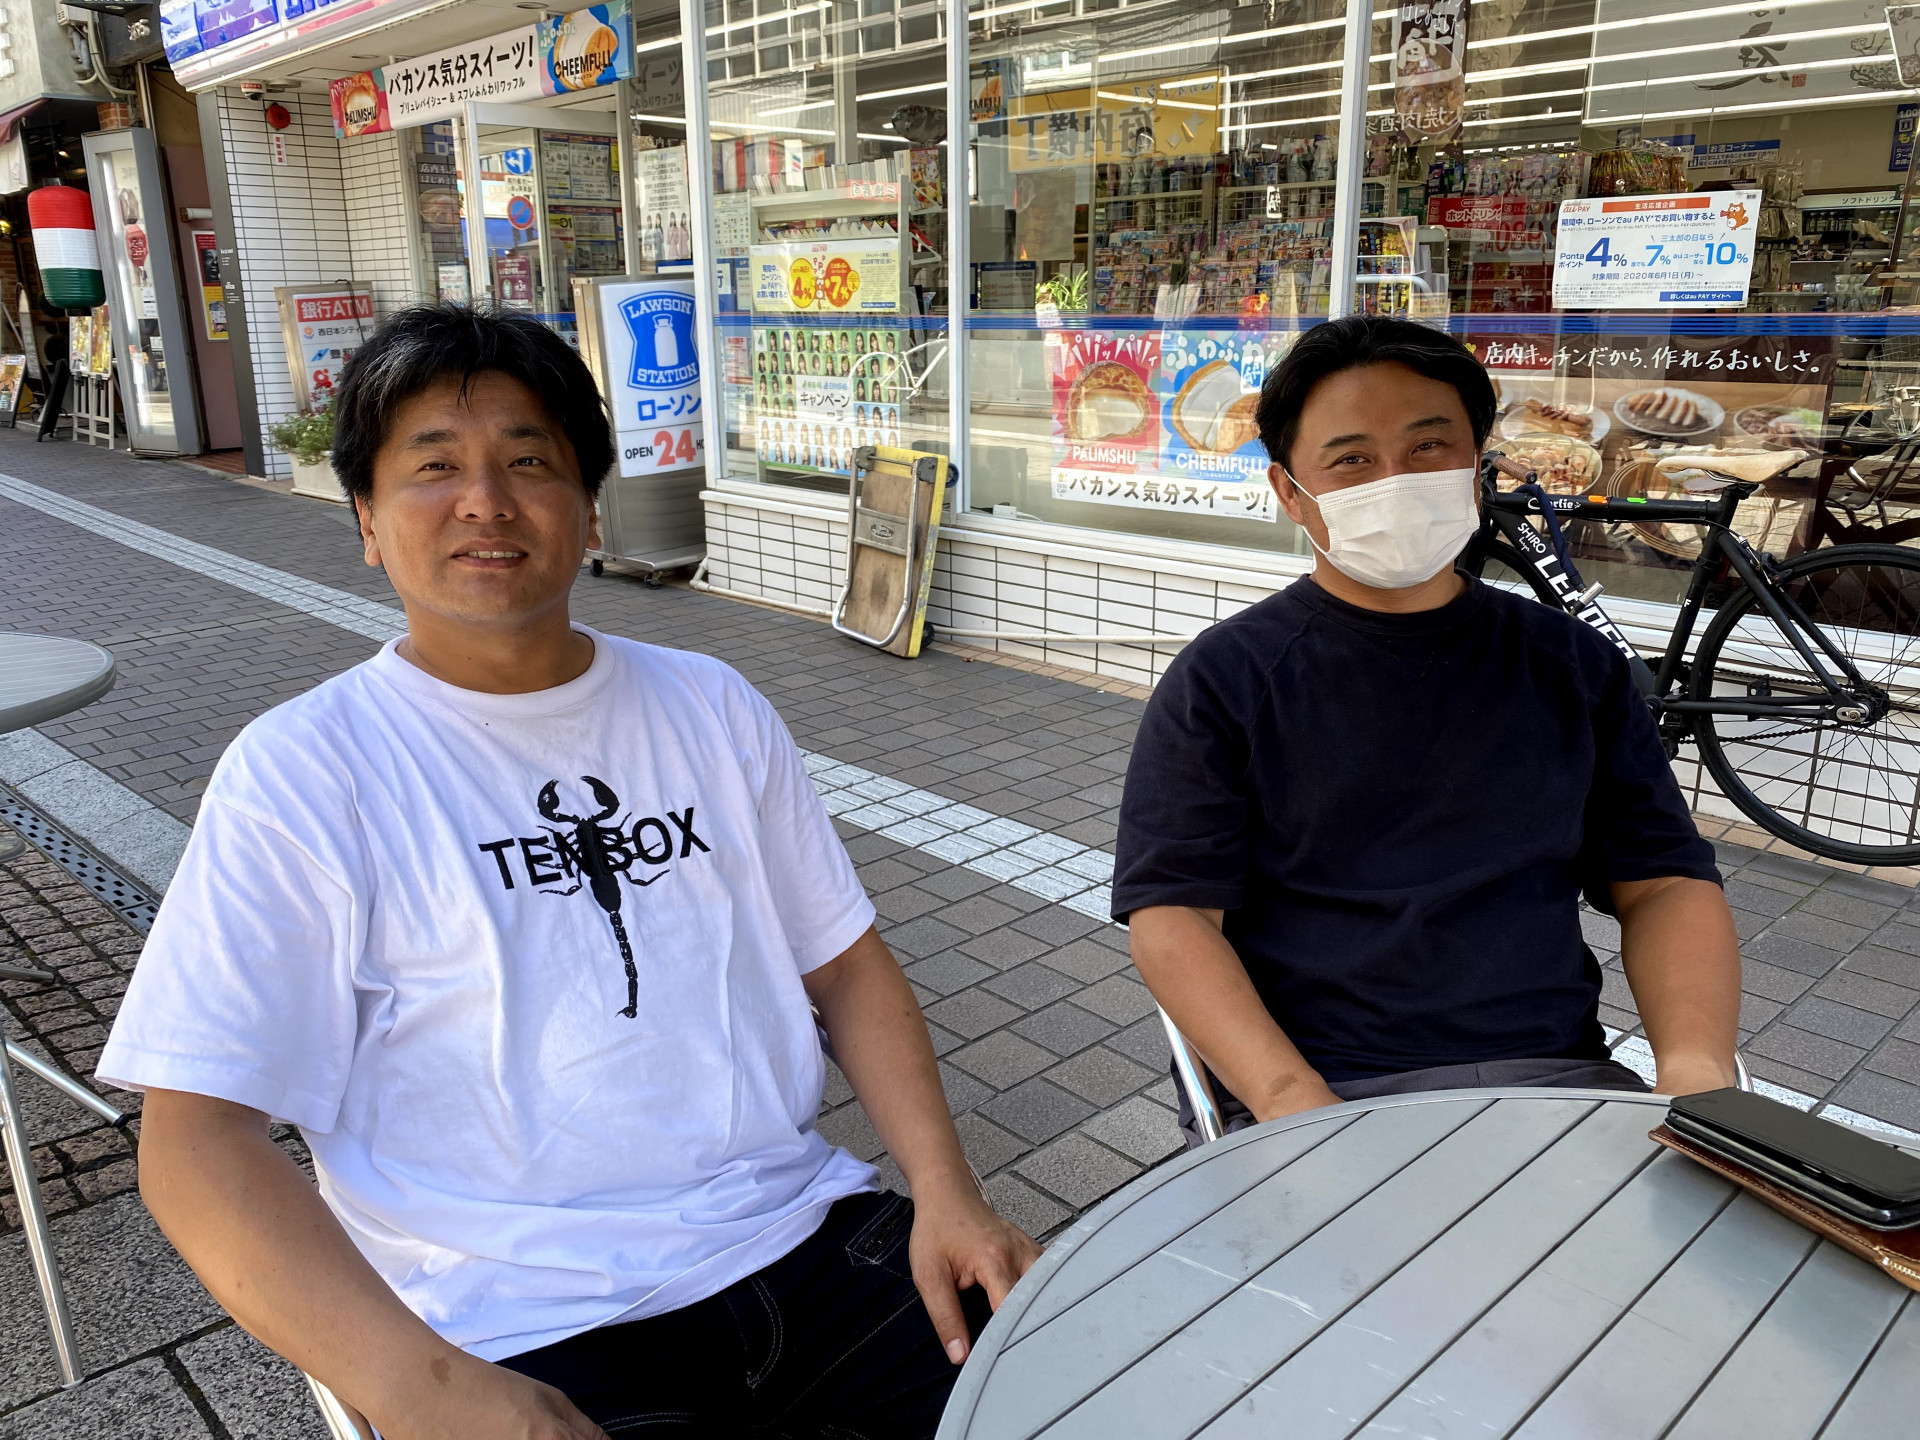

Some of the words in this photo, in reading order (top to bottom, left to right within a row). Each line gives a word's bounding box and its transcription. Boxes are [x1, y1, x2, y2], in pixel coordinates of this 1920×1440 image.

[389, 35, 534, 96] バカンス気分スイーツ!
[553, 50, 613, 79] CHEEMFULL
[1563, 205, 1577, 213] au
[1577, 205, 1591, 213] PAY
[1661, 234, 1714, 242] 三太郎の日なら
[1558, 260, 1584, 268] ポイント
[301, 298, 369, 319] 銀行ATM
[627, 298, 692, 320] LAWSON
[1484, 344, 1820, 373] 店内キッチンだから、作れるおいしさ。
[636, 362, 699, 384] STATION
[637, 393, 702, 422] ローソン
[800, 391, 850, 408] キャンペーン
[624, 445, 653, 460] OPEN
[653, 429, 696, 467] 24
[1072, 445, 1136, 466] PALIMSHU
[1175, 452, 1267, 478] CHEEMFULL
[1069, 475, 1269, 513] バカンス気分スイーツ!
[1527, 497, 1573, 508] Crlie
[1517, 522, 1547, 554] SHIRO
[478, 807, 712, 890] TENBOX
